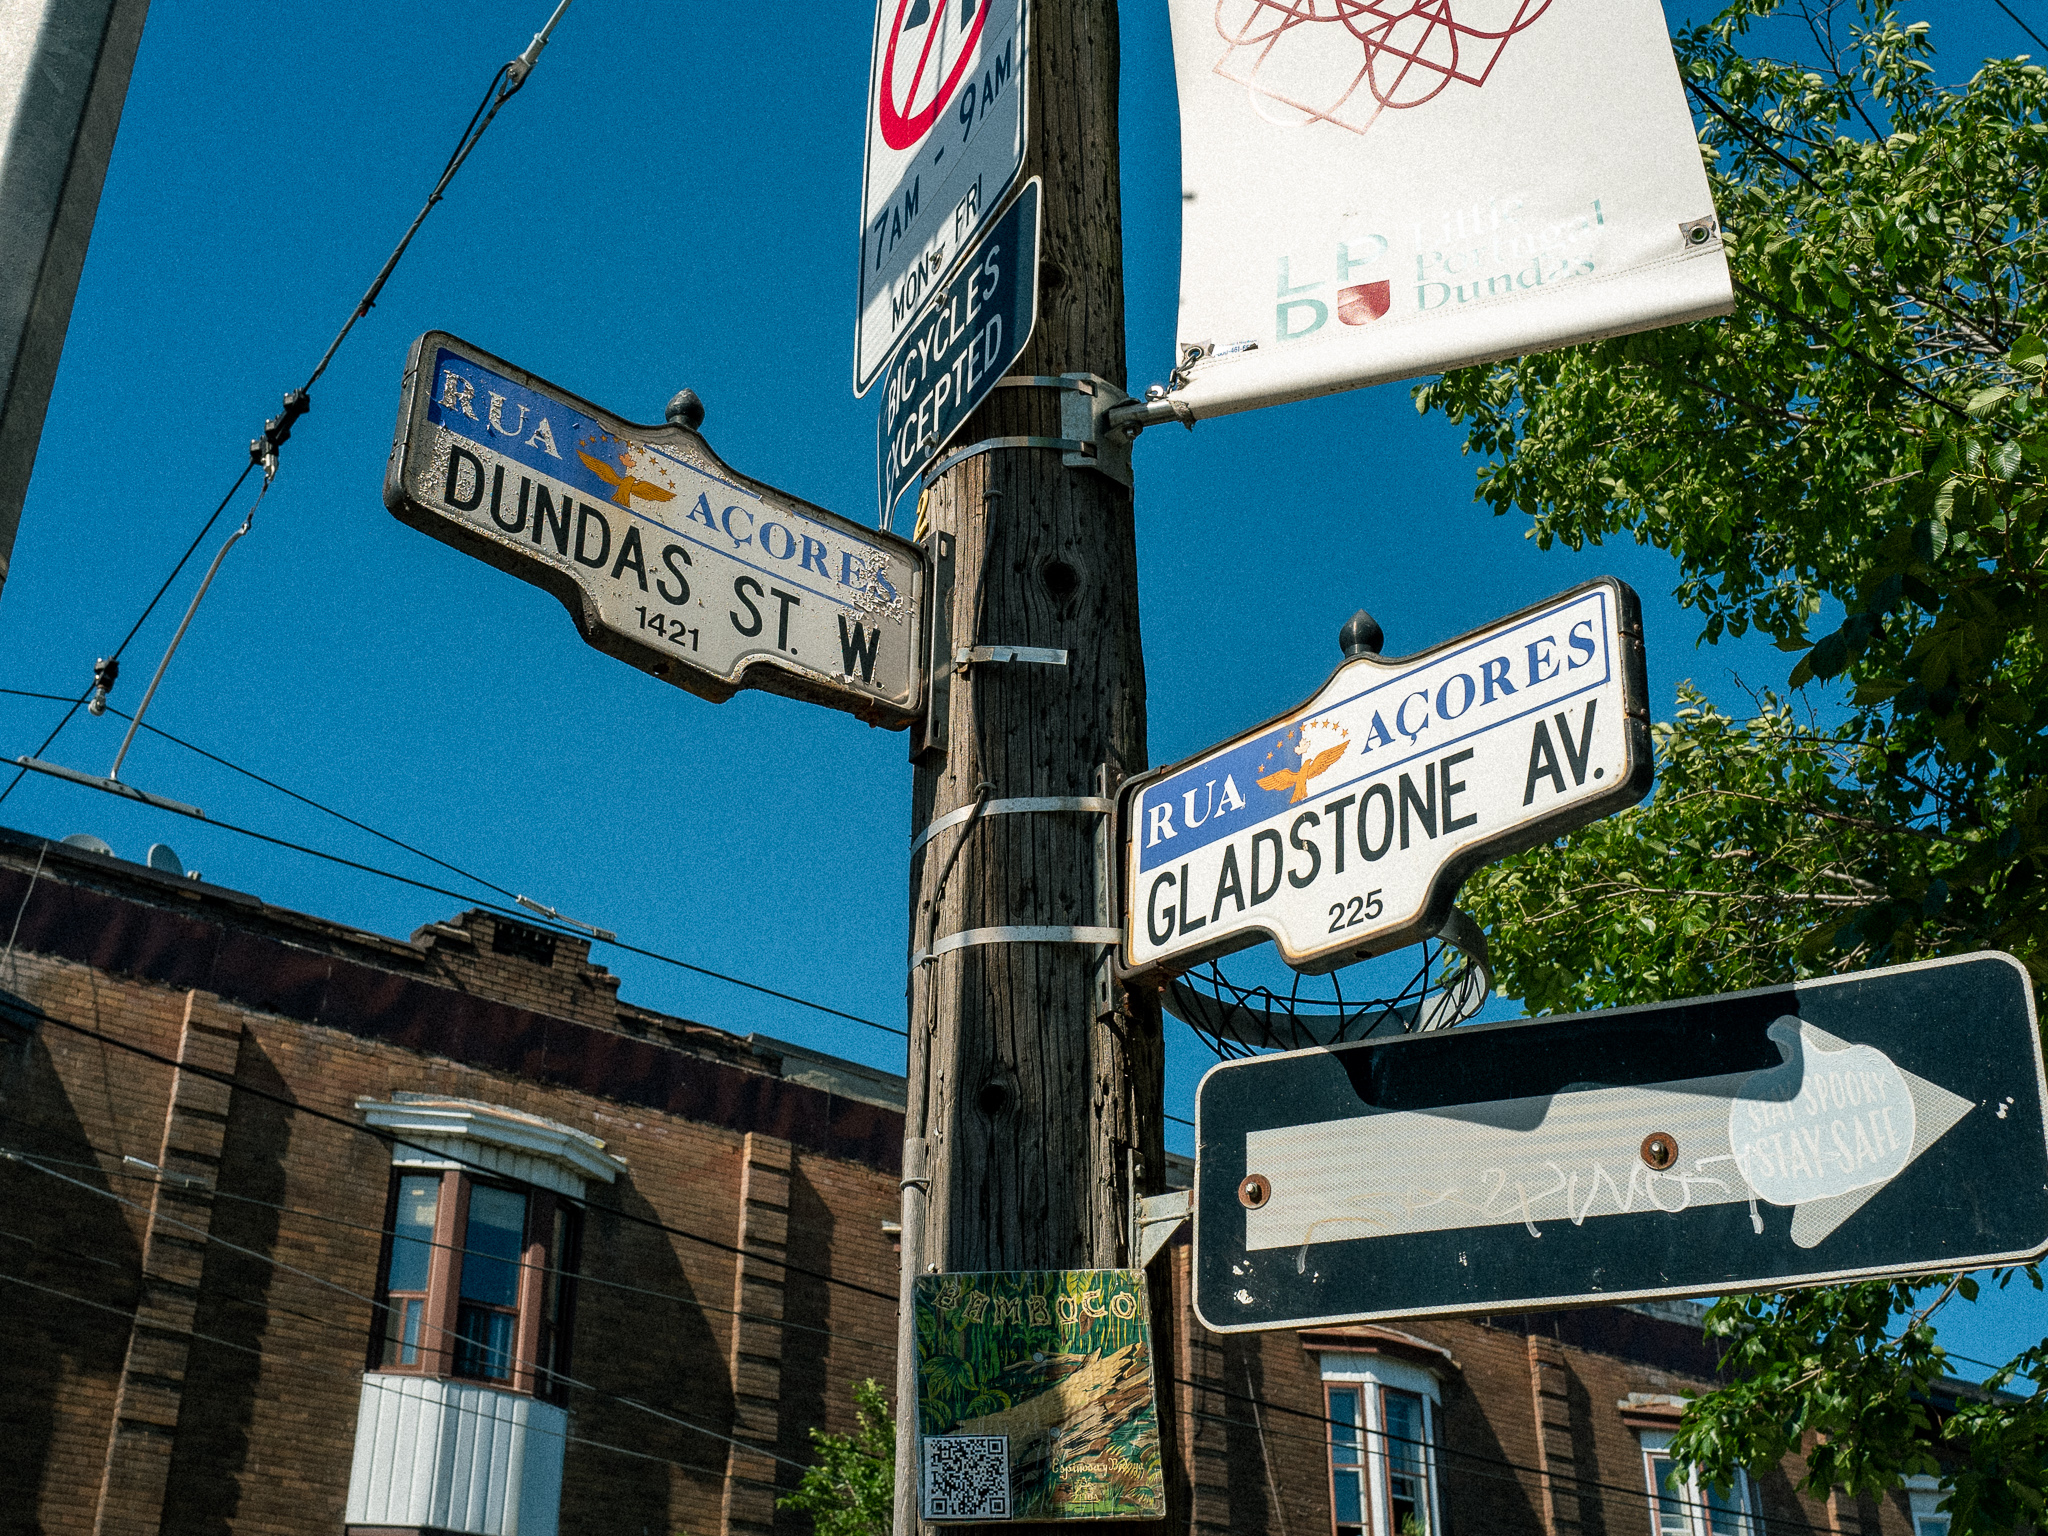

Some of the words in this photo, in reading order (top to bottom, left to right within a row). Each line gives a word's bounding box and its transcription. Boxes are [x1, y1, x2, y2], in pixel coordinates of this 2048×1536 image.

[892, 252, 928, 333] MON
[955, 173, 982, 243] FRI
[1416, 254, 1596, 311] Dundas
[885, 314, 1001, 505] EXCEPTED
[887, 245, 1000, 437] BICYCLES
[438, 370, 562, 460] RUA
[687, 492, 901, 604] AÇORES
[444, 444, 692, 607] DUNDAS
[730, 576, 800, 655] ST.
[838, 614, 884, 690] W.
[635, 605, 700, 652] 1421
[1147, 773, 1245, 849] RUA
[1361, 620, 1595, 754] AÇORES
[1147, 748, 1477, 947] GLADSTONE
[1523, 699, 1604, 807] AV.
[1328, 890, 1383, 934] 225
[1748, 1080, 1795, 1132] STAY
[1803, 1071, 1886, 1116] SPOOKY
[1755, 1125, 1824, 1179] STAY
[1831, 1106, 1901, 1174] SAFE
[932, 1280, 1137, 1327] BAMBUCO
